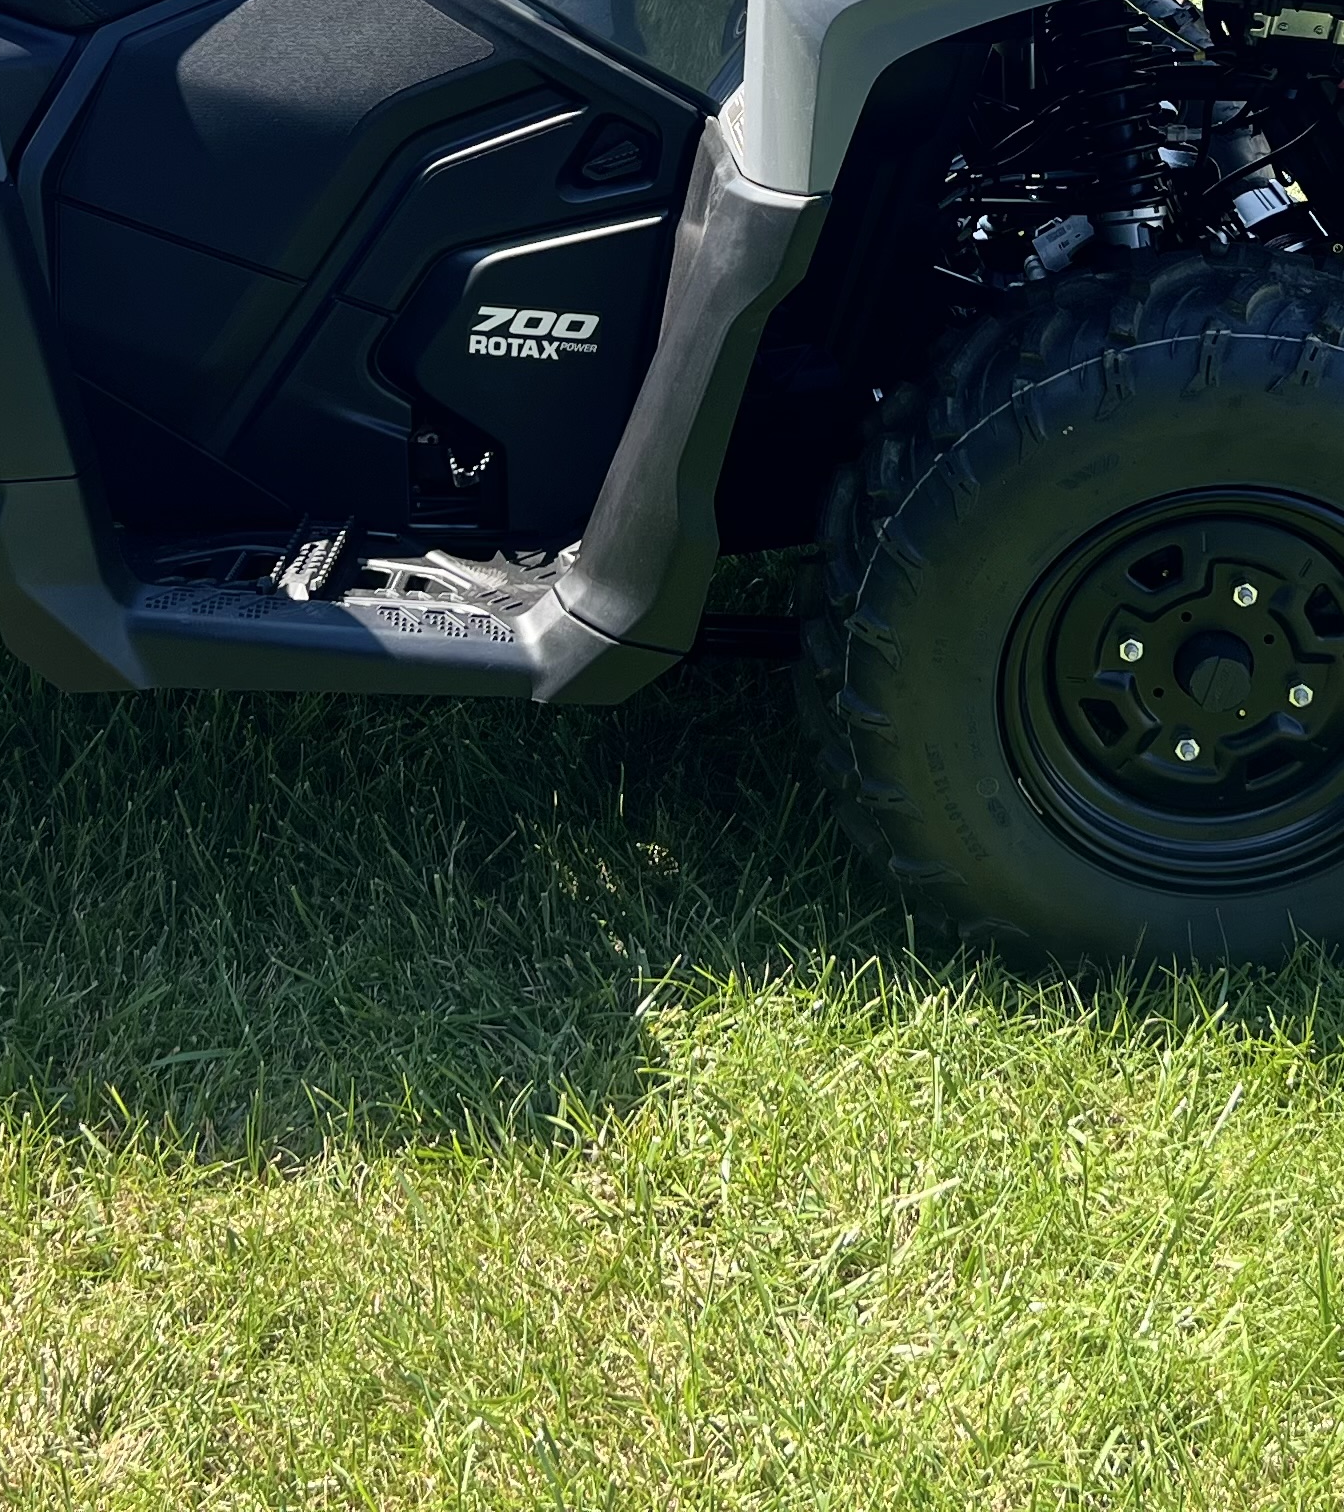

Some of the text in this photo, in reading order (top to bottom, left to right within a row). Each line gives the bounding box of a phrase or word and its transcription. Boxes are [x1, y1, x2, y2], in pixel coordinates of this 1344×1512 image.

[471, 306, 600, 340] 700
[468, 334, 598, 360] ROTAX POWER
